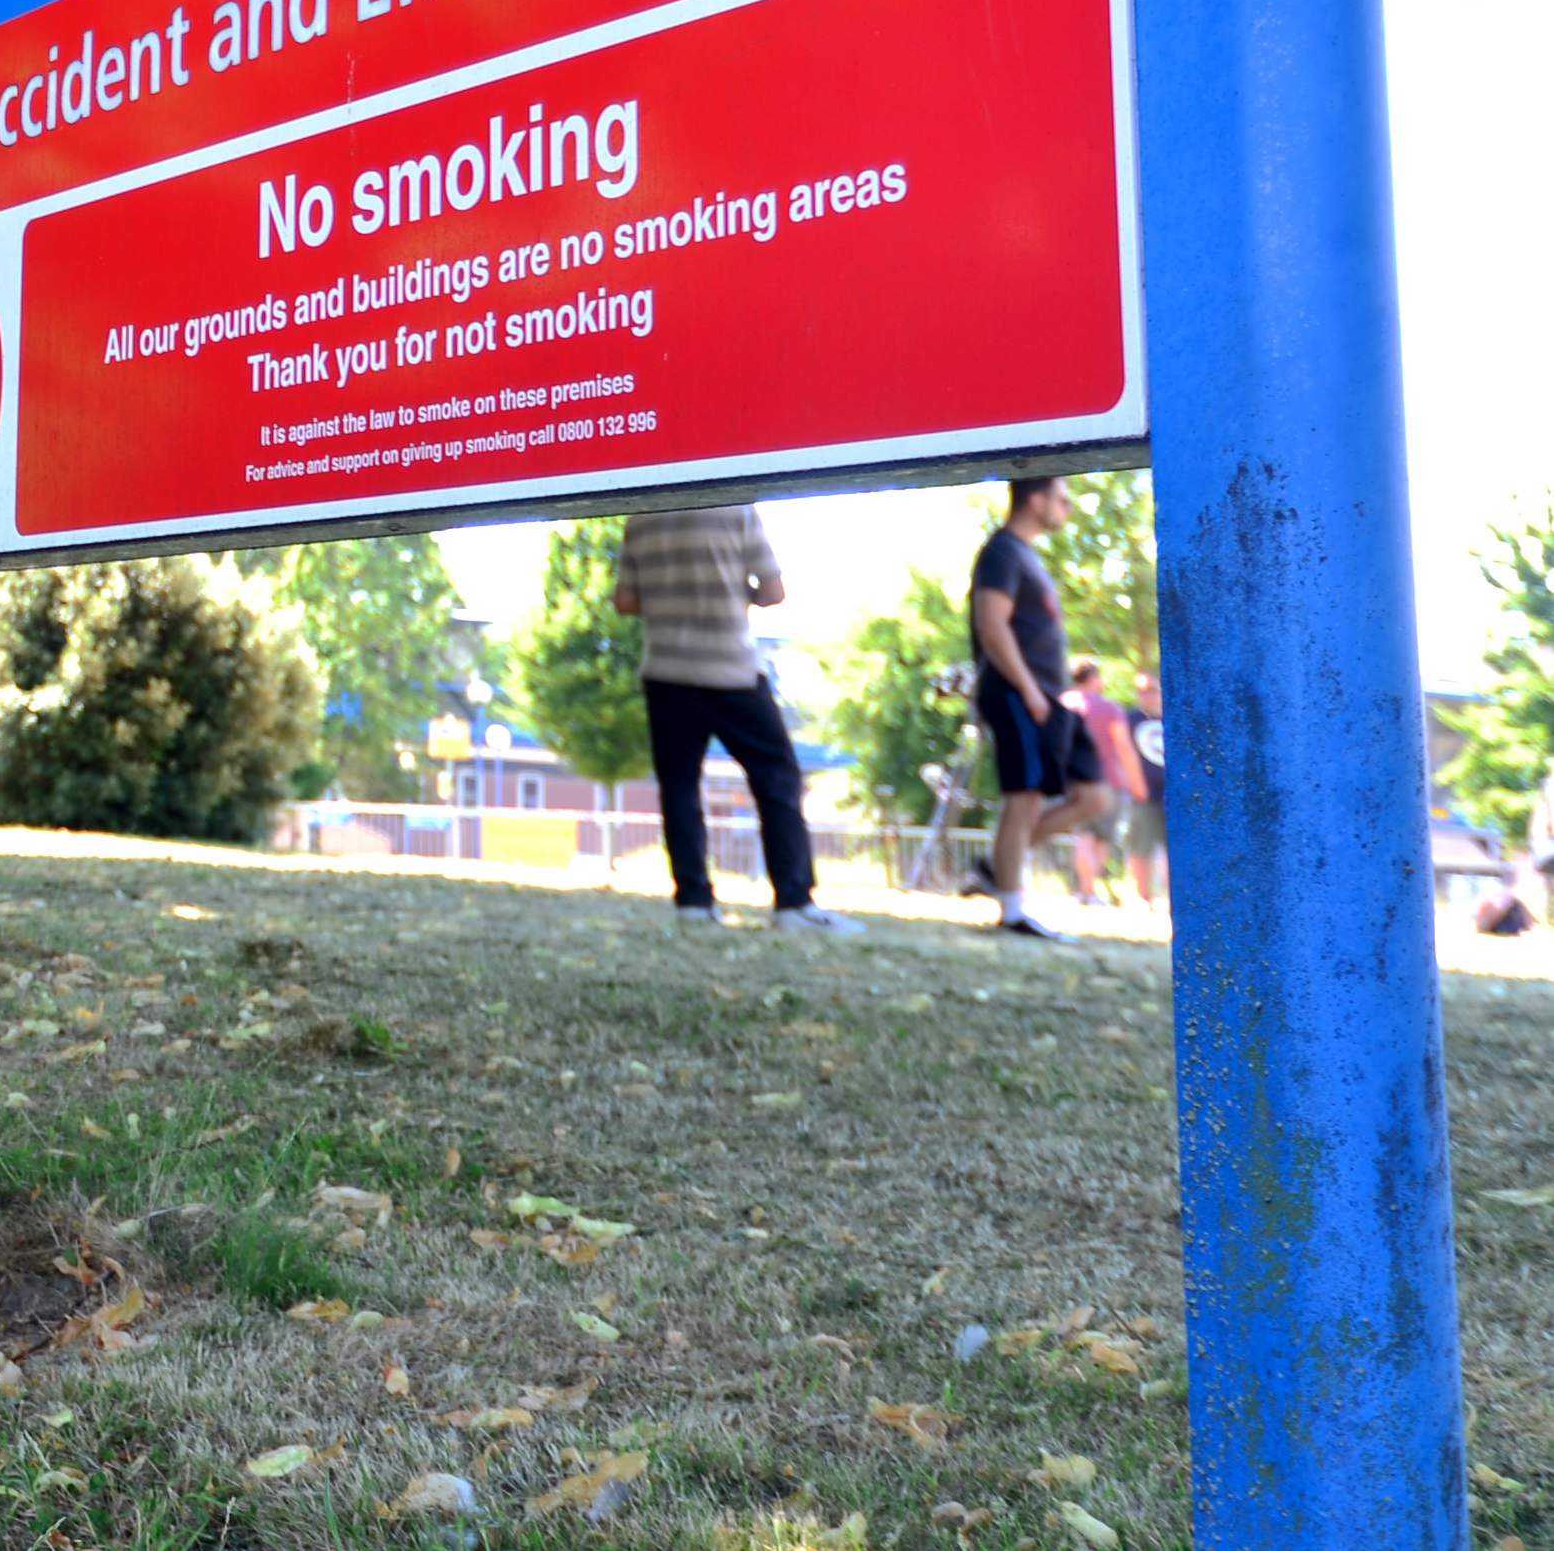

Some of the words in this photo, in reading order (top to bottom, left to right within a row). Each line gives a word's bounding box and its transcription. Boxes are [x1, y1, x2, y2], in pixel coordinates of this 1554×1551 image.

[259, 173, 334, 259] No
[351, 99, 639, 235] smoking
[103, 324, 134, 364] All
[139, 322, 180, 357] our
[184, 293, 288, 357] grounds
[294, 277, 345, 325] and
[352, 255, 490, 313] buildings
[498, 242, 551, 283] are
[560, 230, 605, 270] no
[613, 191, 777, 259] smoking
[789, 163, 907, 223] areas
[246, 342, 330, 392] Thank
[334, 339, 387, 388] you
[394, 325, 438, 367] for
[445, 311, 497, 358] not
[504, 286, 653, 348] smoking
[246, 464, 266, 482] For
[267, 459, 305, 480] advice
[307, 455, 329, 474] and
[331, 448, 380, 473] support
[382, 448, 399, 464] on
[401, 441, 442, 467] giving
[445, 440, 463, 460] up
[465, 430, 526, 452] smoking
[528, 424, 555, 446] call
[558, 419, 594, 442] 0800
[596, 415, 625, 437] 132
[627, 410, 657, 433] 996
[261, 426, 271, 446] It
[273, 424, 286, 444] is
[288, 415, 340, 446] against
[342, 412, 367, 434] the
[369, 409, 396, 430] law
[398, 405, 415, 426] to
[417, 396, 471, 423] smoke
[474, 395, 496, 415] on
[499, 388, 547, 411] these
[551, 373, 635, 409] premises
